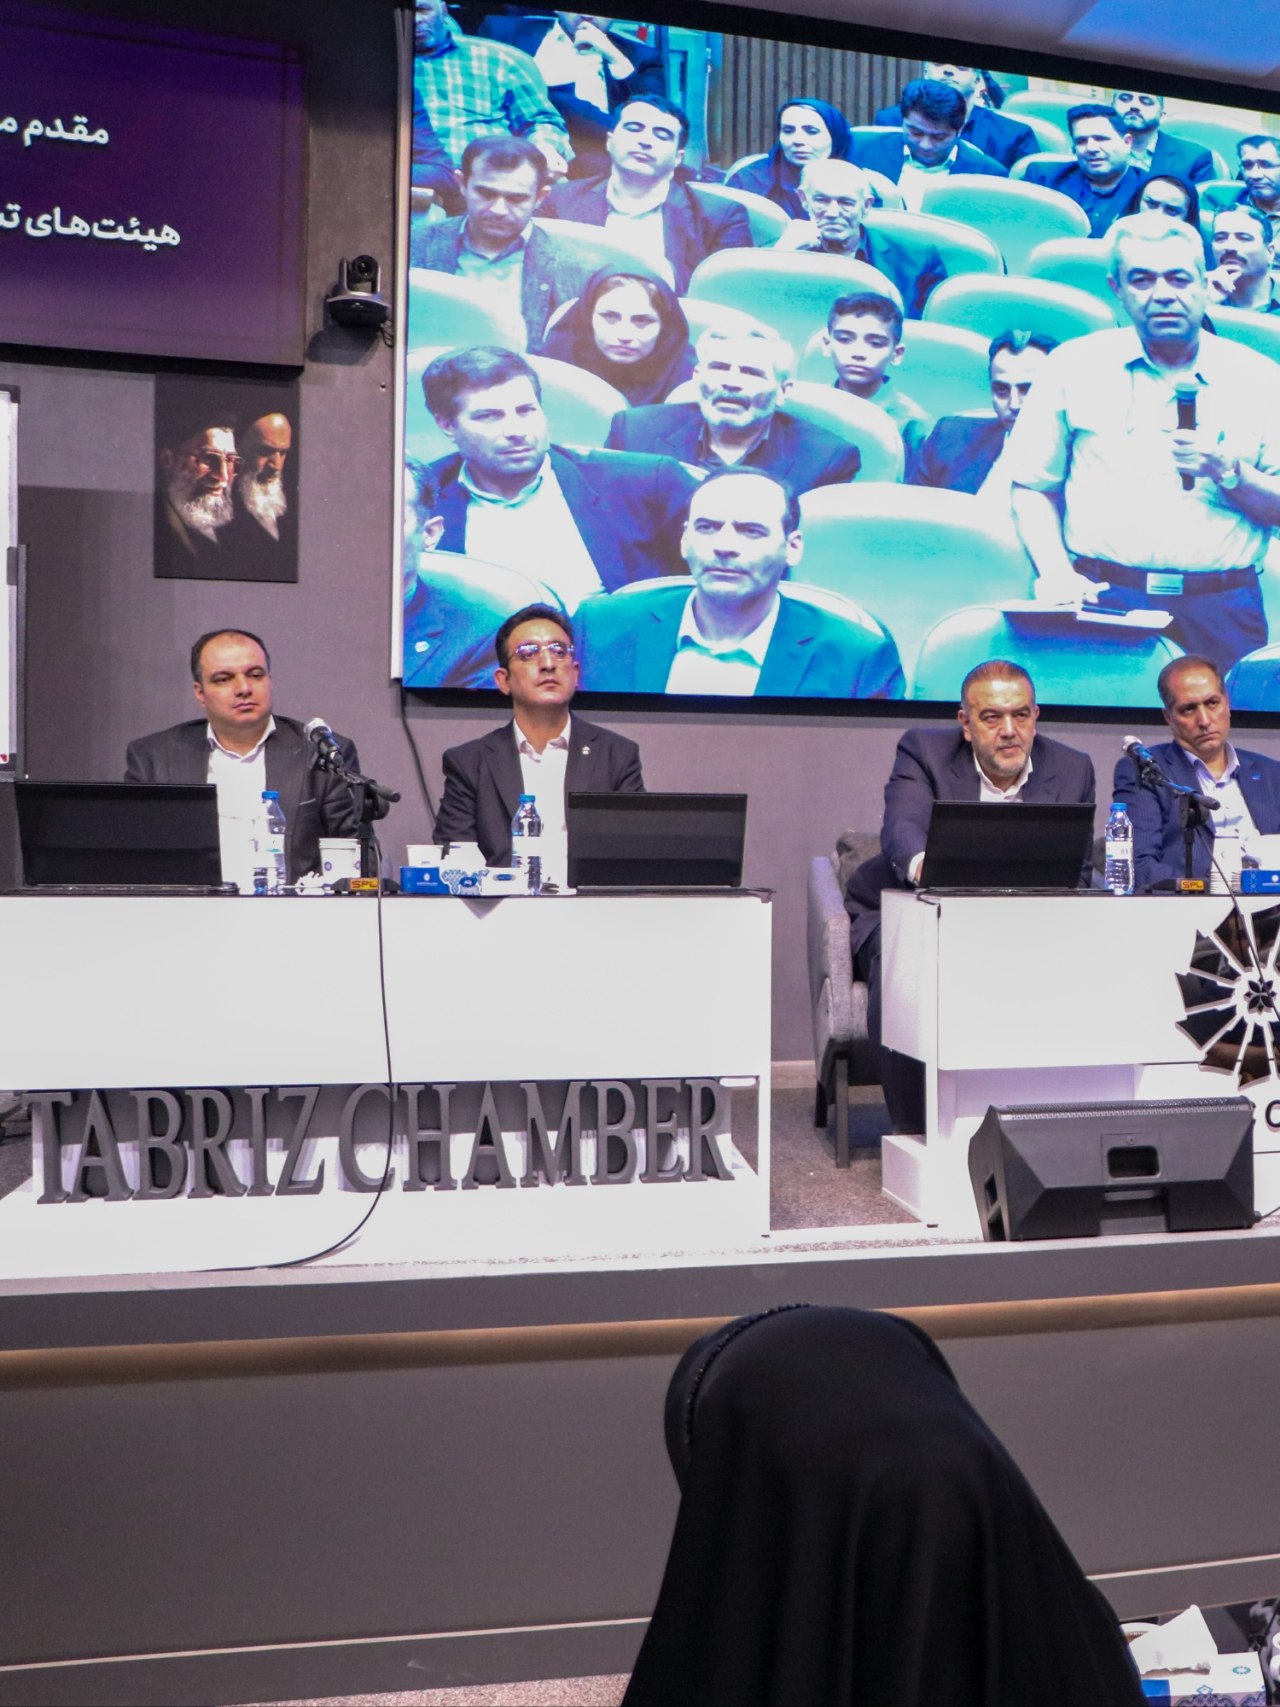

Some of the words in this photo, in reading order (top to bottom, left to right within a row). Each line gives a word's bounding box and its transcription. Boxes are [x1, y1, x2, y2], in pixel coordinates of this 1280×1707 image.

[24, 115, 109, 147] مقدم
[1182, 880, 1204, 889] SPL
[23, 1085, 325, 1205] TABRIZ
[338, 1078, 736, 1193] CHAMBER
